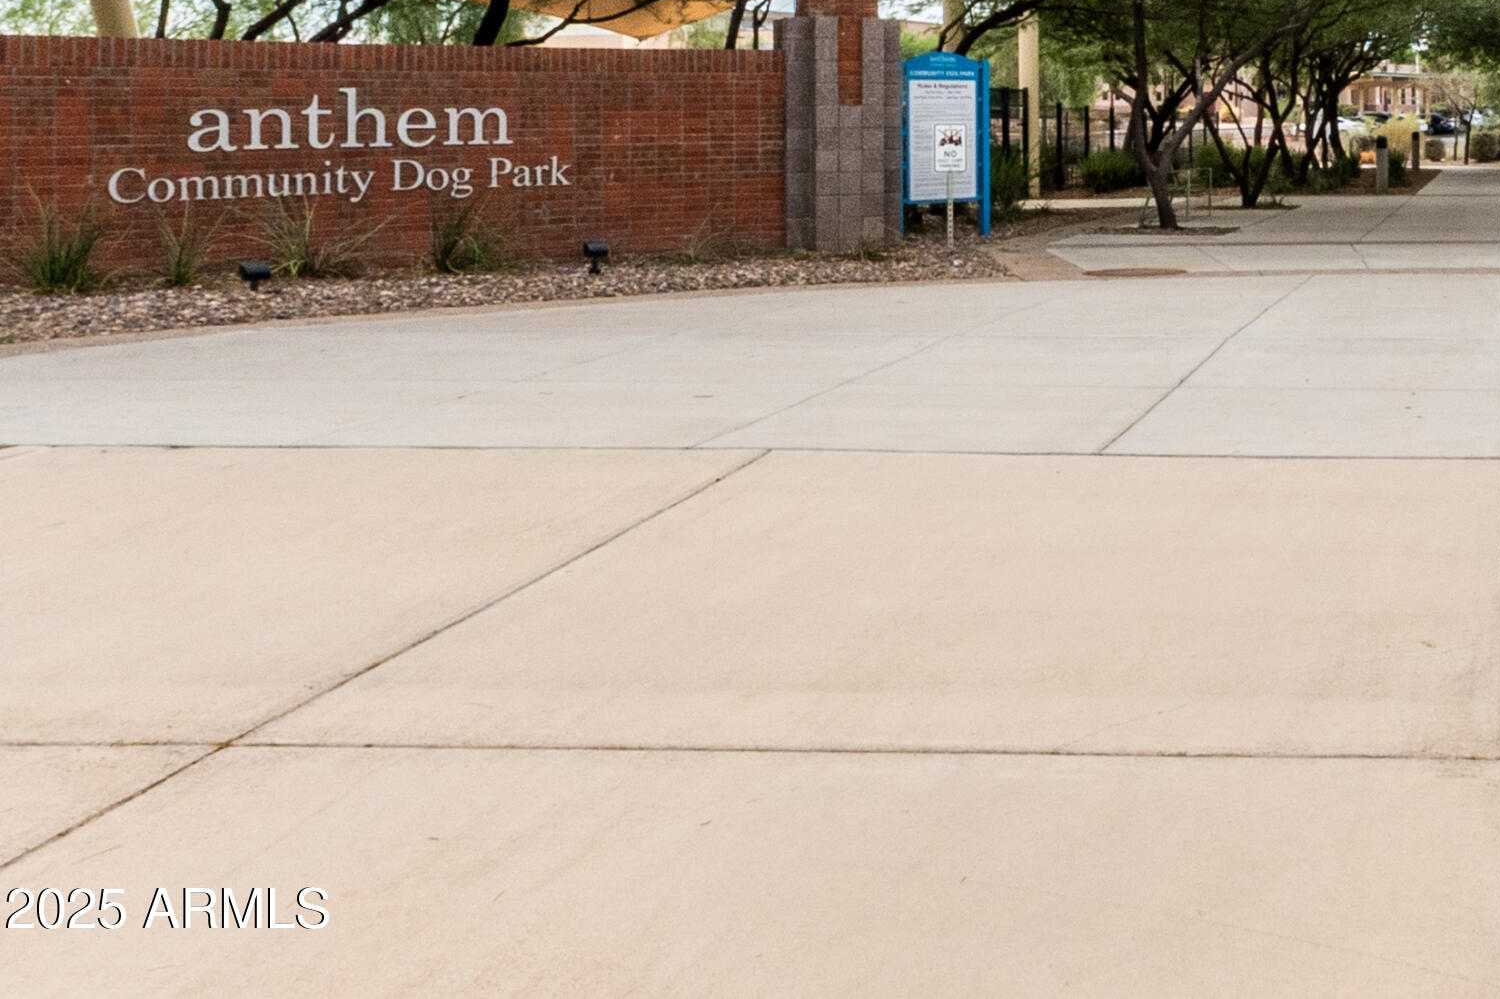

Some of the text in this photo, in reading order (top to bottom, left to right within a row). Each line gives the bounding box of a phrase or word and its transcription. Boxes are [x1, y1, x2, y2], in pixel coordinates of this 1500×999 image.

[186, 87, 514, 153] anthem
[944, 150, 957, 158] NO
[107, 156, 572, 204] Community Dog Park
